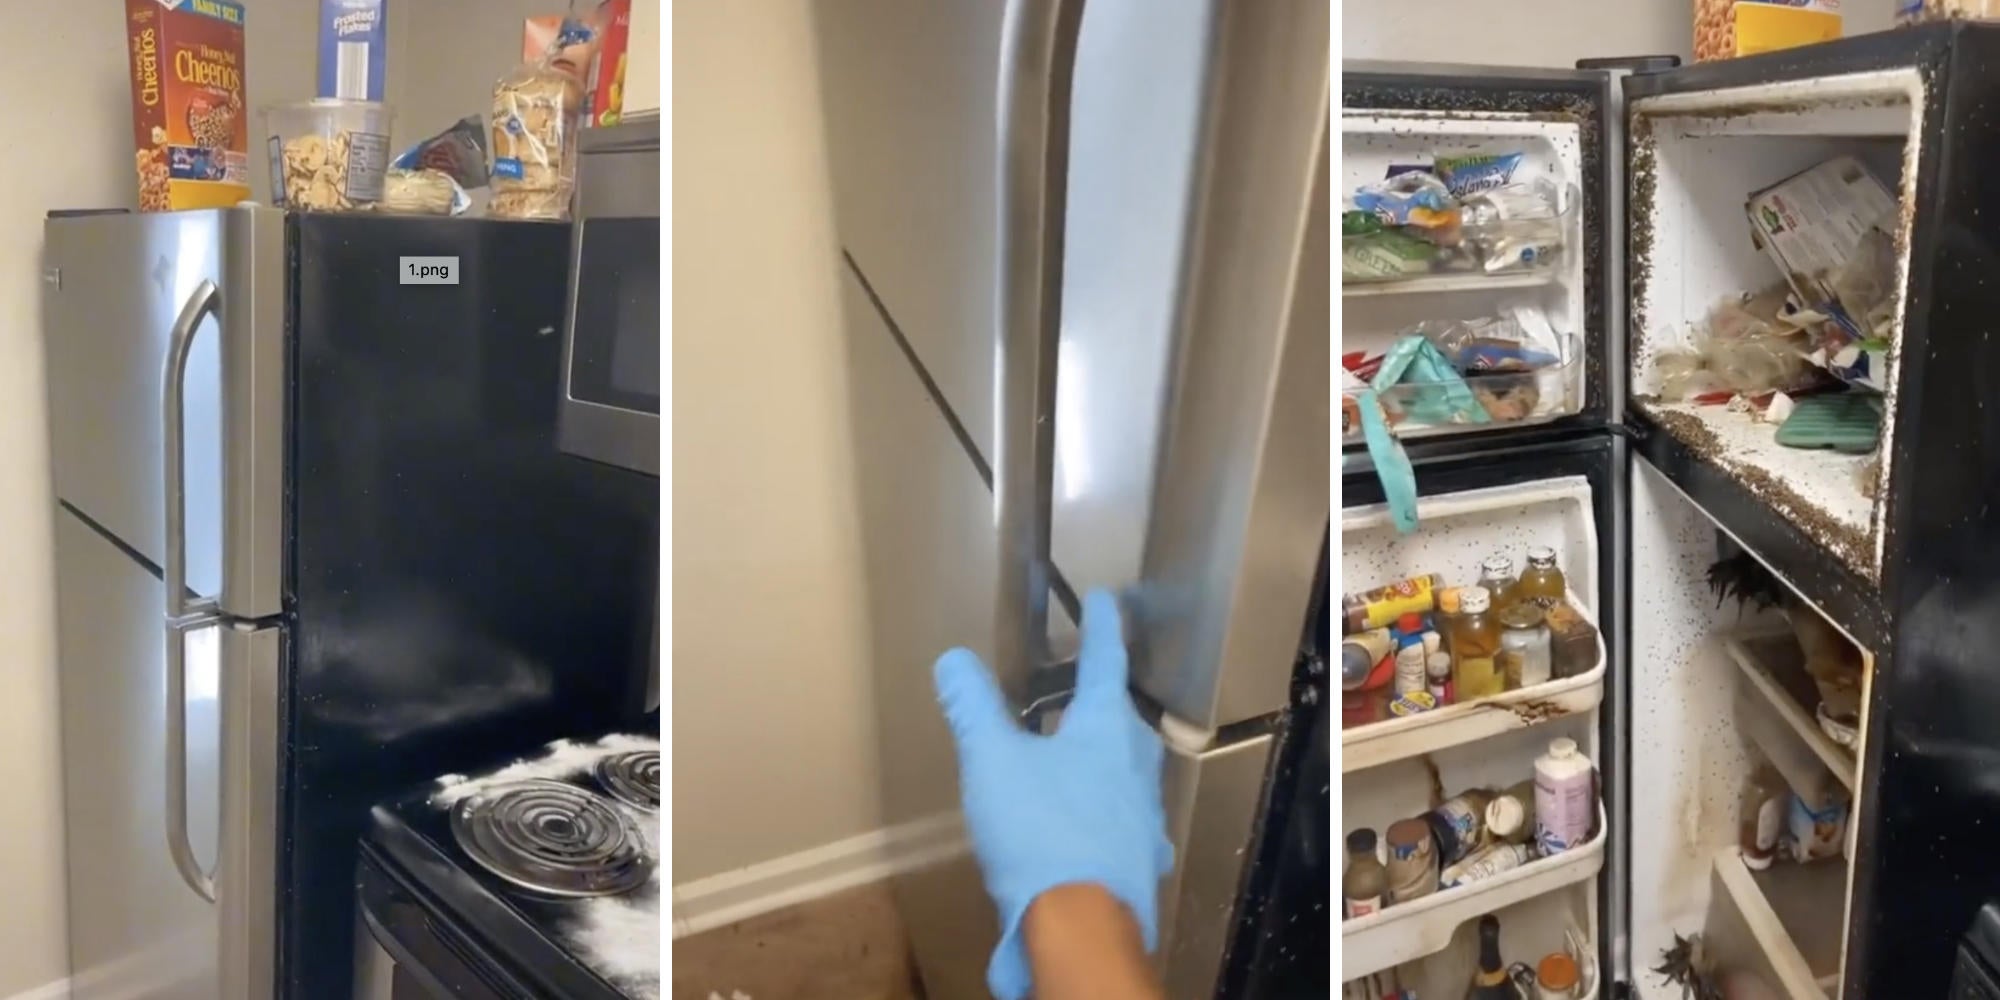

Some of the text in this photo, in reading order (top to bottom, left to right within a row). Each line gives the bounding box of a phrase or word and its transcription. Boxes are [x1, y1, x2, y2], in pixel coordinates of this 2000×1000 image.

[333, 10, 375, 29] Frosted
[142, 28, 159, 106] Cheerios
[175, 49, 240, 90] Cheerios
